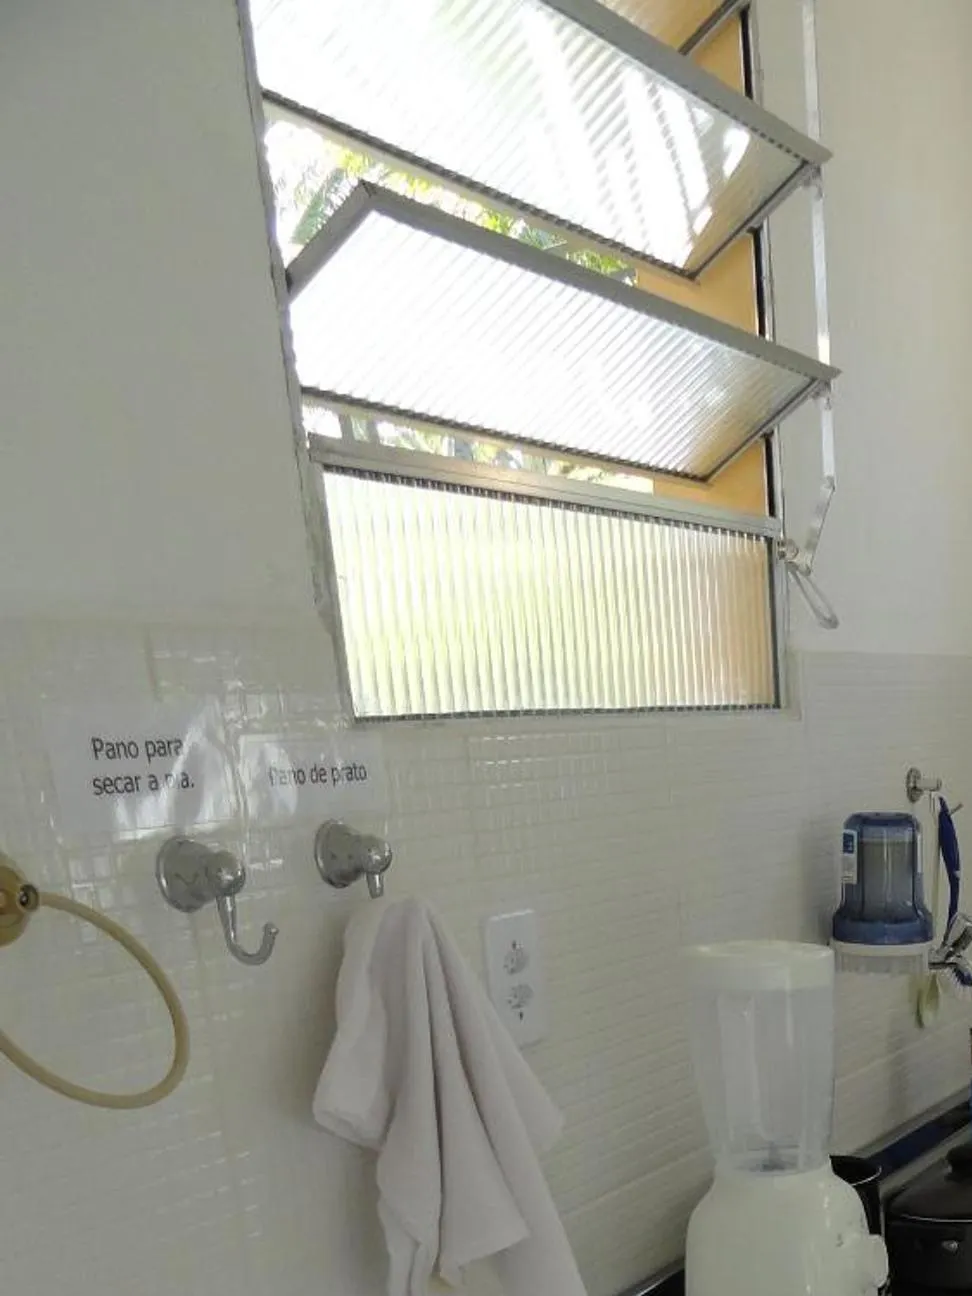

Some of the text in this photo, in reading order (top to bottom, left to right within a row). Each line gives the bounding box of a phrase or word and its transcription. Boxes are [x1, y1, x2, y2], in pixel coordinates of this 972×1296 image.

[91, 737, 183, 764] Pano para
[93, 775, 141, 796] secar
[148, 774, 159, 791] a
[310, 764, 327, 784] de
